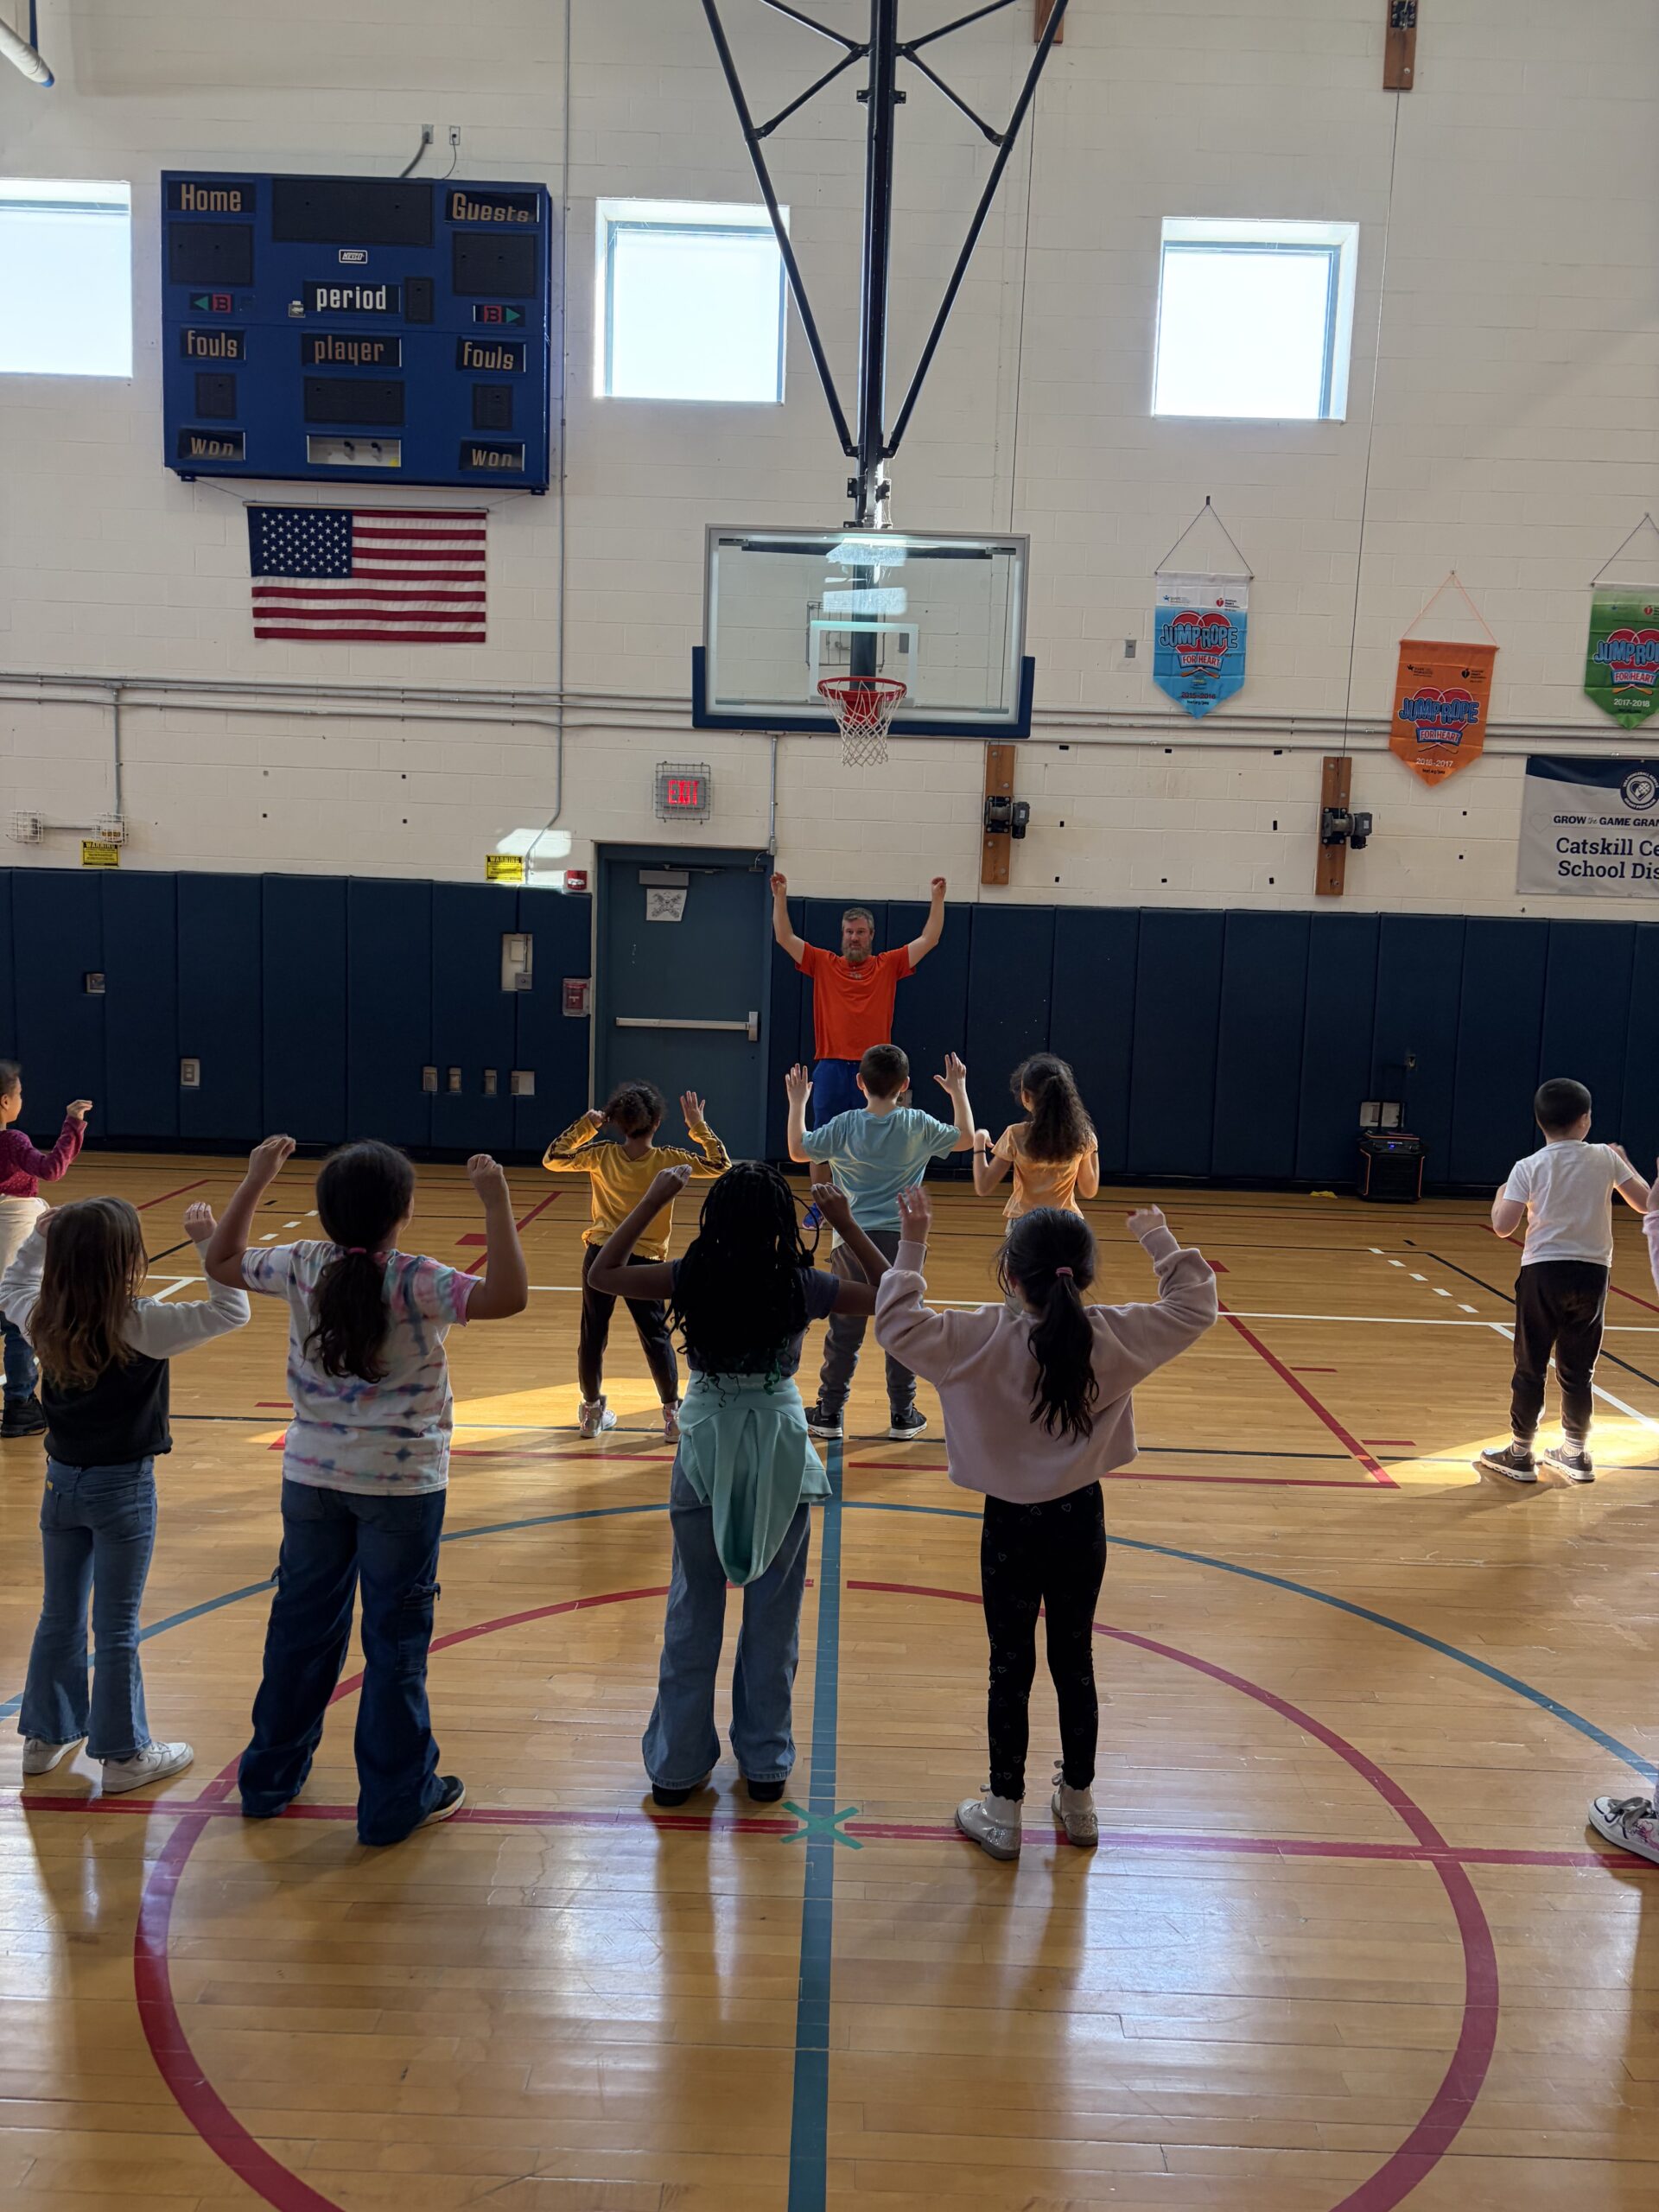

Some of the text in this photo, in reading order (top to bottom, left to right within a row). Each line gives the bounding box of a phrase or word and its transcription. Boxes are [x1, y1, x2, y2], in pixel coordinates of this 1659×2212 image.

[181, 184, 241, 211] Home
[452, 193, 529, 222] Guests
[317, 285, 386, 311] period
[188, 330, 237, 357] fouls
[315, 335, 384, 365] player
[464, 341, 514, 369] fouls
[1182, 655, 1220, 667] FOR HEART
[1615, 672, 1654, 683] FOR HEART
[1614, 698, 1650, 707] 2017-2018
[1421, 730, 1459, 742] FOR HEART
[668, 779, 699, 805] EXIT
[1554, 815, 1586, 824] GROW
[1599, 817, 1631, 826] GAME
[1557, 837, 1633, 855] Catskill
[1558, 860, 1625, 878] School
